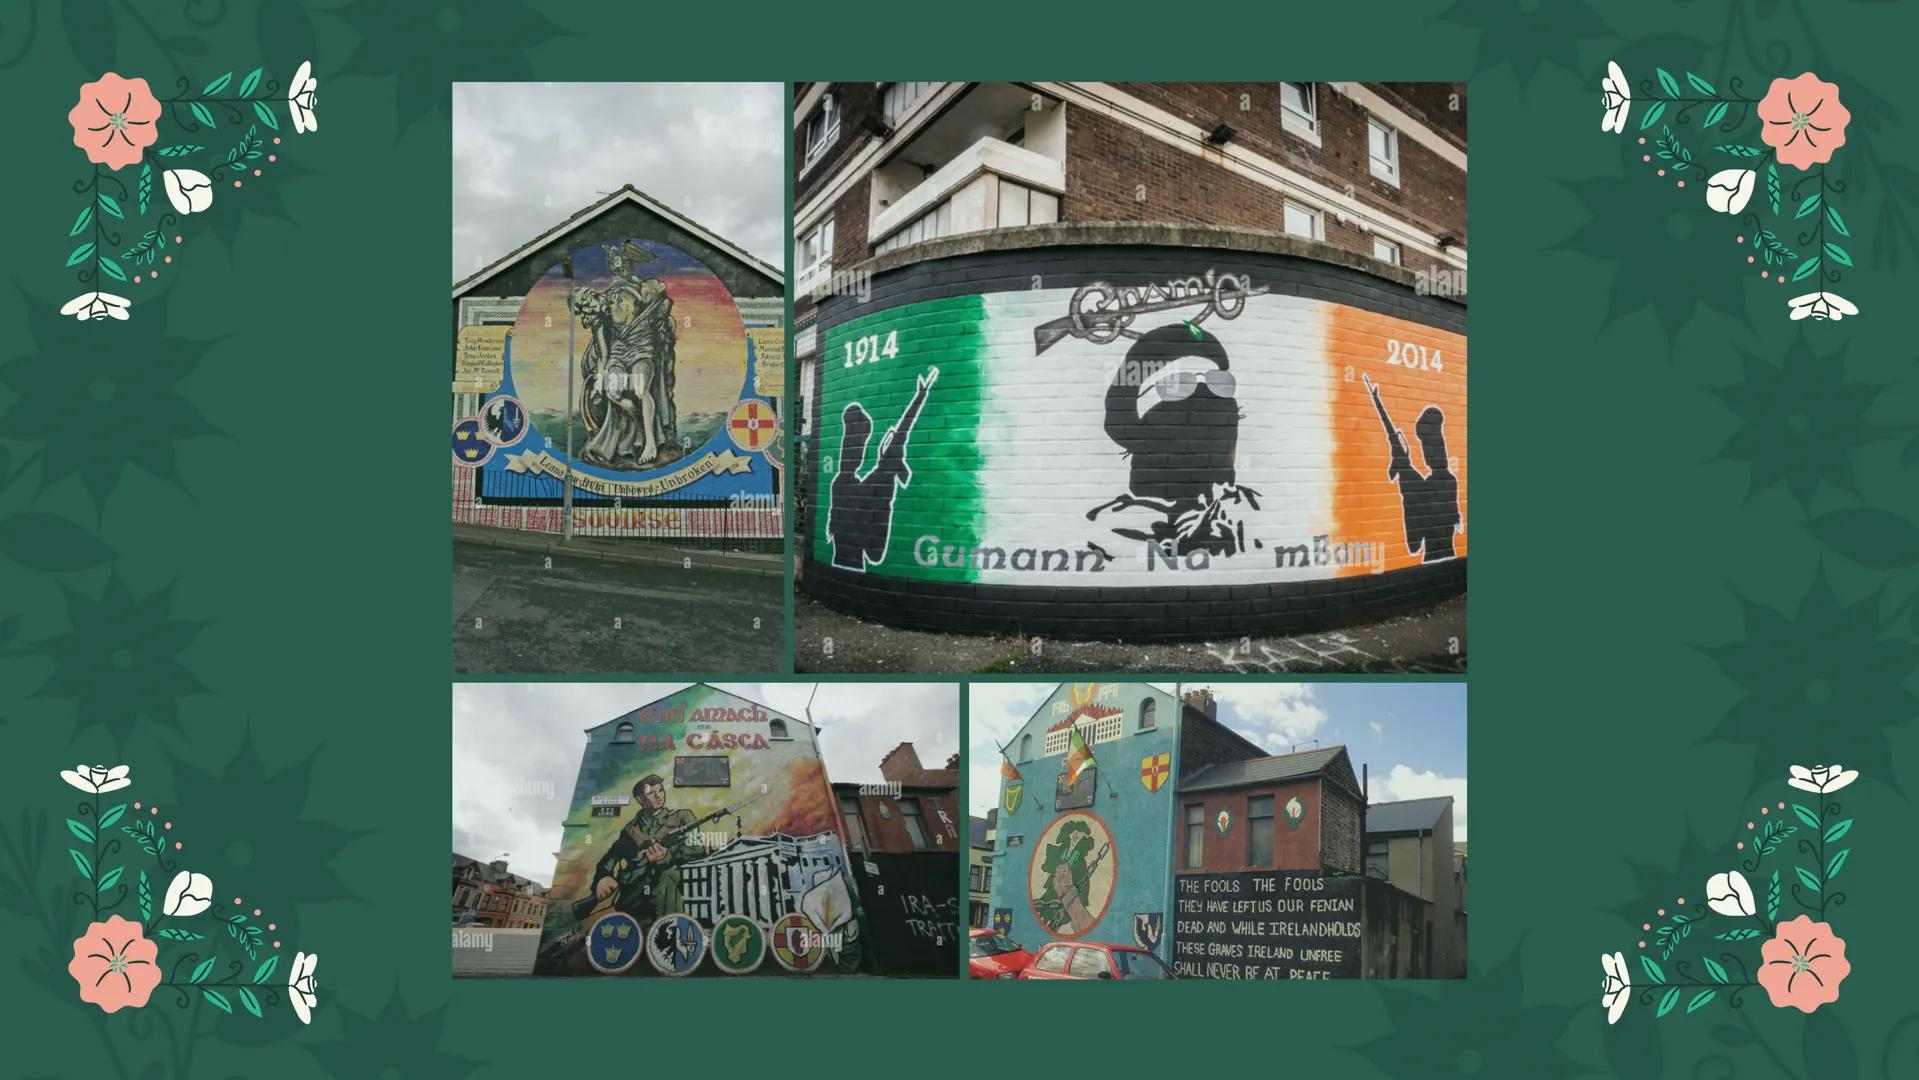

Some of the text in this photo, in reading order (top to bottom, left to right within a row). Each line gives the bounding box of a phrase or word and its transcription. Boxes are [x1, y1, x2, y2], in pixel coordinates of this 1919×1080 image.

[844, 329, 899, 368] 1914
[1386, 338, 1444, 373] 2014
[1180, 877, 1324, 893] THE FOOLS THE FOOLS
[1179, 900, 1202, 913] THEY
[1207, 901, 1229, 912] HAVE
[1278, 899, 1304, 912] OUR
[1310, 899, 1354, 912] FENIAN
[1177, 921, 1204, 934] DEAD
[1207, 922, 1226, 934] AND
[1232, 921, 1265, 935] WHILE
[1176, 942, 1342, 962] THESE GRAVES IRELAND UNFREE
[1173, 961, 1204, 978] SHALL
[1206, 961, 1240, 979] NEVER
[1264, 966, 1281, 979] AT
